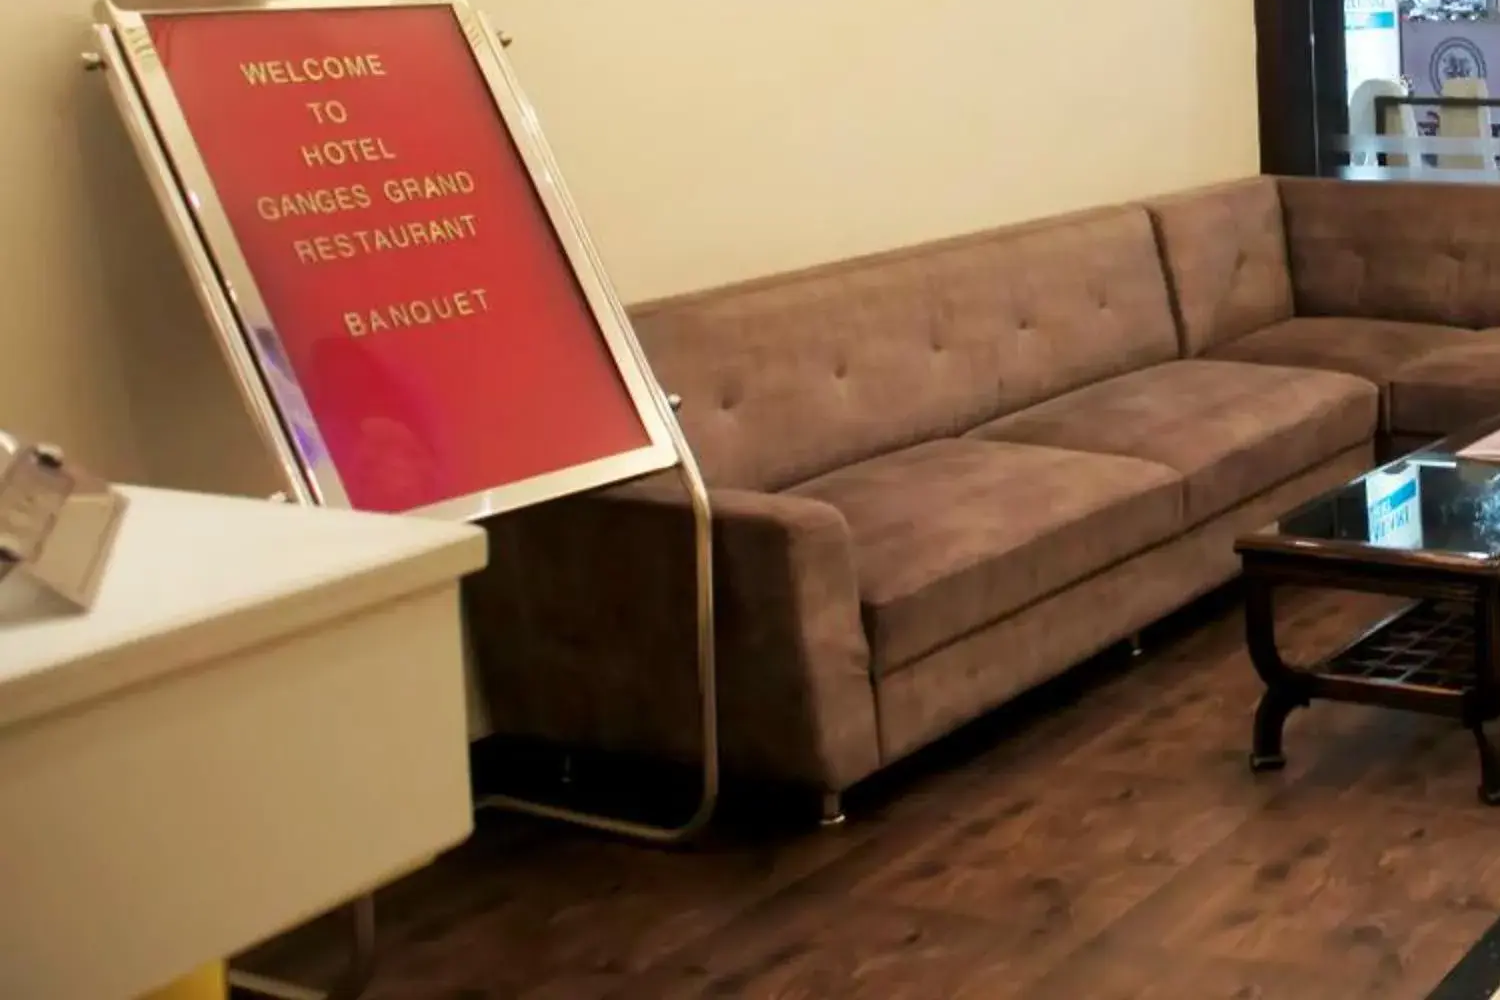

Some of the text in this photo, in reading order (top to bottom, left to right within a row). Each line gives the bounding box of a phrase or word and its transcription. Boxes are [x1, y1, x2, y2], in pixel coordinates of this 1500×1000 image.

[239, 53, 388, 86] WELCOME
[306, 99, 348, 125] TO
[301, 137, 397, 167] HOTEL
[257, 170, 475, 222] GANGES GRAND
[293, 213, 477, 265] RESTAURANT
[344, 288, 488, 338] BANQUET
